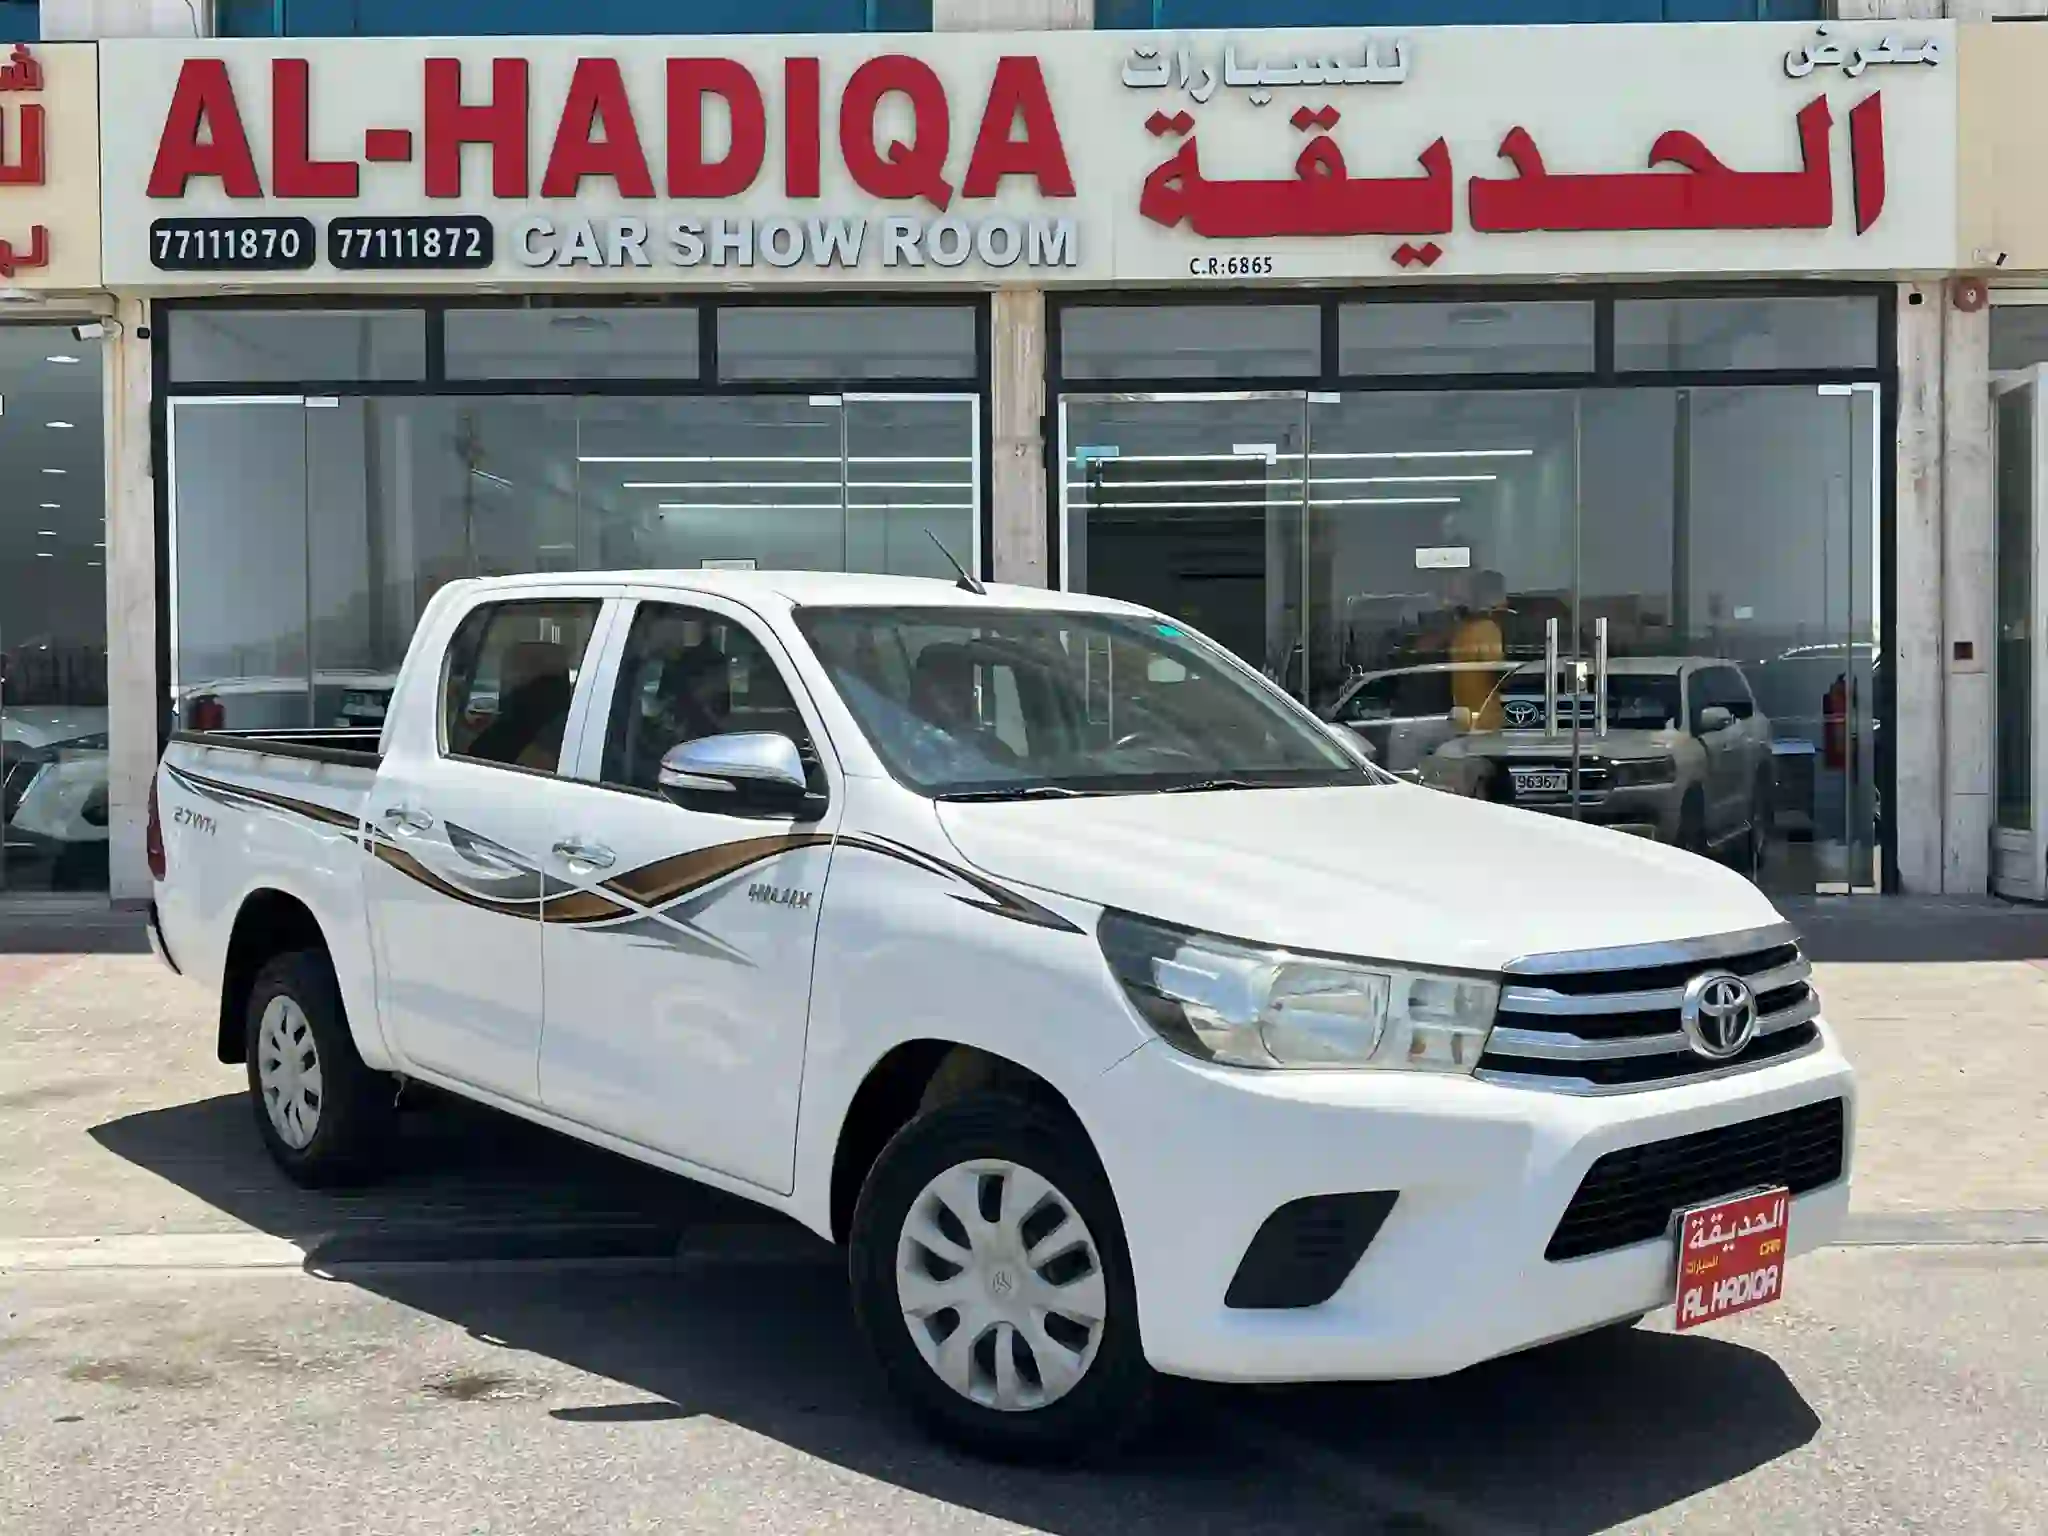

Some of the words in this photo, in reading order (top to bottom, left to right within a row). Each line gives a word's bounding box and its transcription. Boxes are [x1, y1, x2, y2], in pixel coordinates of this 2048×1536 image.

[1122, 38, 1408, 106] للسيارات
[1784, 24, 1939, 78] معرض
[146, 54, 1077, 211] AL-HADIQA
[1139, 90, 1886, 268] الحديقة
[156, 228, 301, 259] 77111870
[336, 227, 483, 259] 77111872
[520, 217, 651, 268] CAR
[670, 217, 868, 267] SHOW
[884, 217, 1078, 266] ROOM
[1189, 256, 1273, 275] C.R:6865
[1688, 1198, 1785, 1252] الحديقة
[1682, 1285, 1709, 1323] AL
[1711, 1264, 1778, 1313] HADIQA
